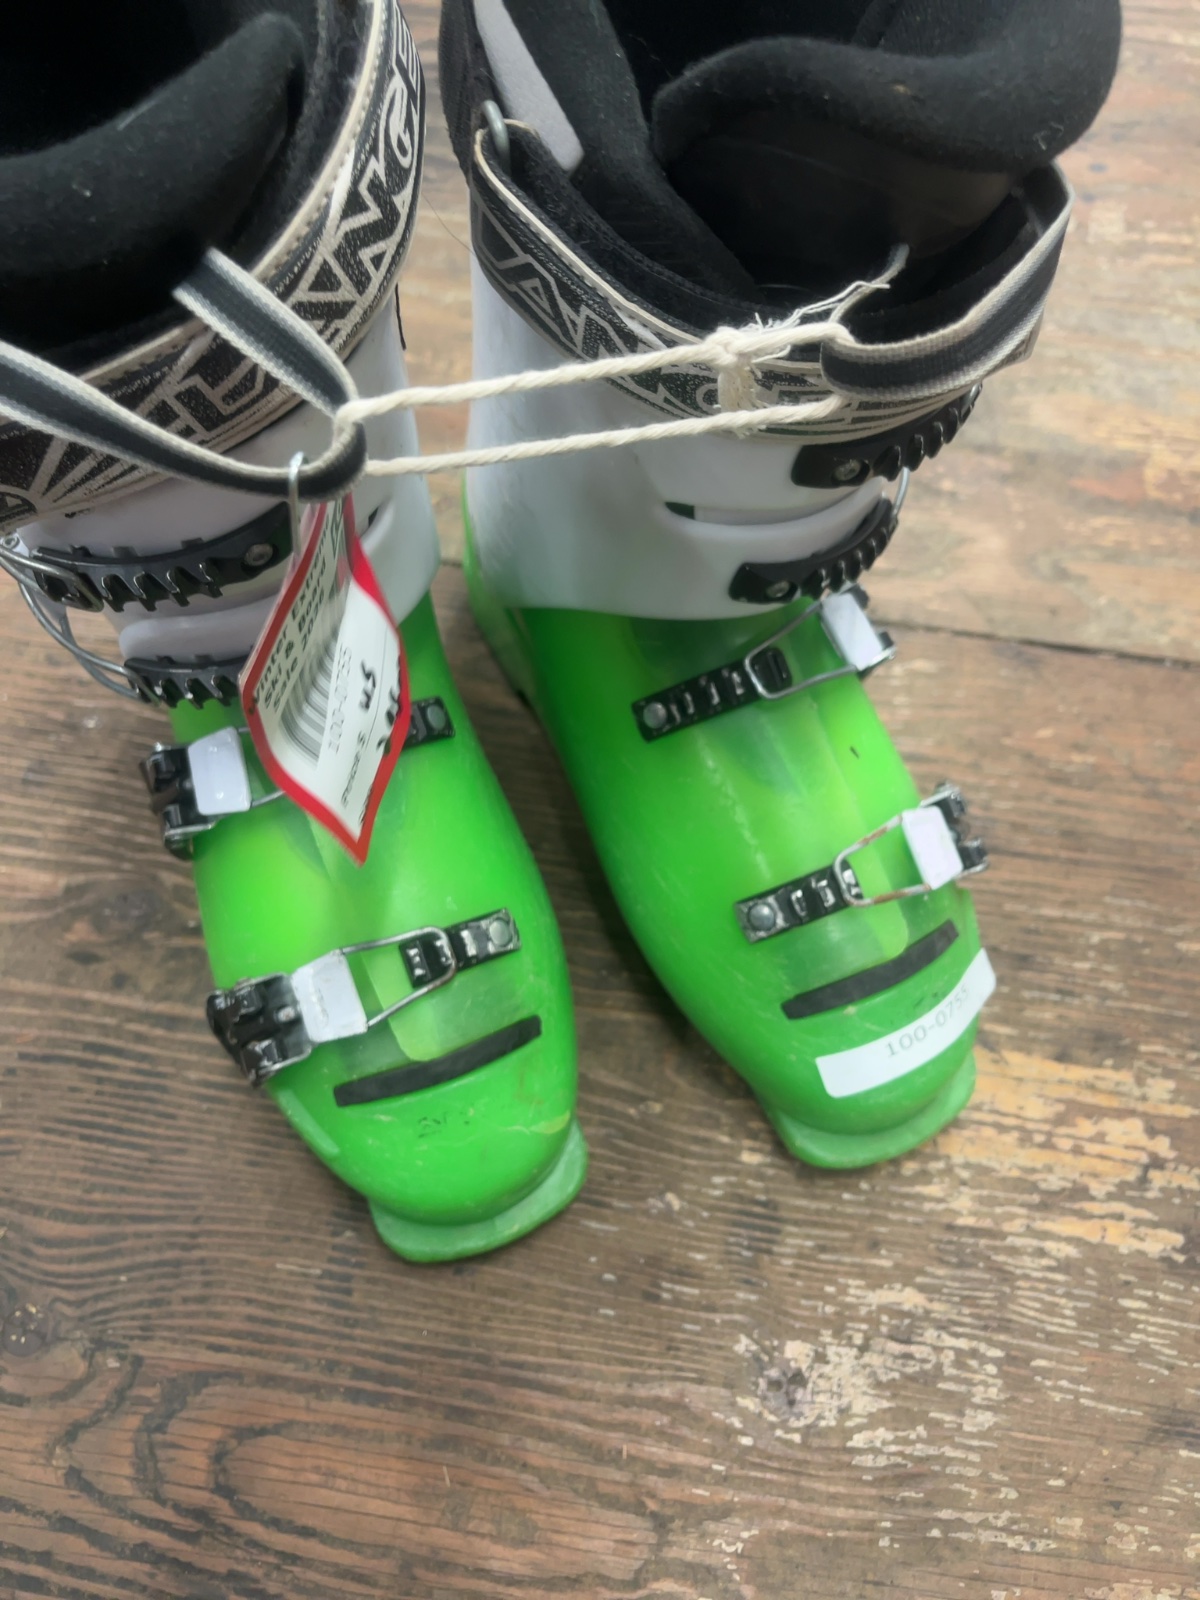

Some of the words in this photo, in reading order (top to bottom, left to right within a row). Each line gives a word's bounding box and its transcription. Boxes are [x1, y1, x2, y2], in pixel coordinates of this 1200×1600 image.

[248, 624, 288, 714] Winter
[264, 665, 284, 710] Ski
[284, 640, 296, 660] &
[298, 555, 327, 634] Board
[273, 656, 298, 713] Sale
[328, 642, 352, 755] 100-0755
[884, 982, 969, 1057] 100-0755
